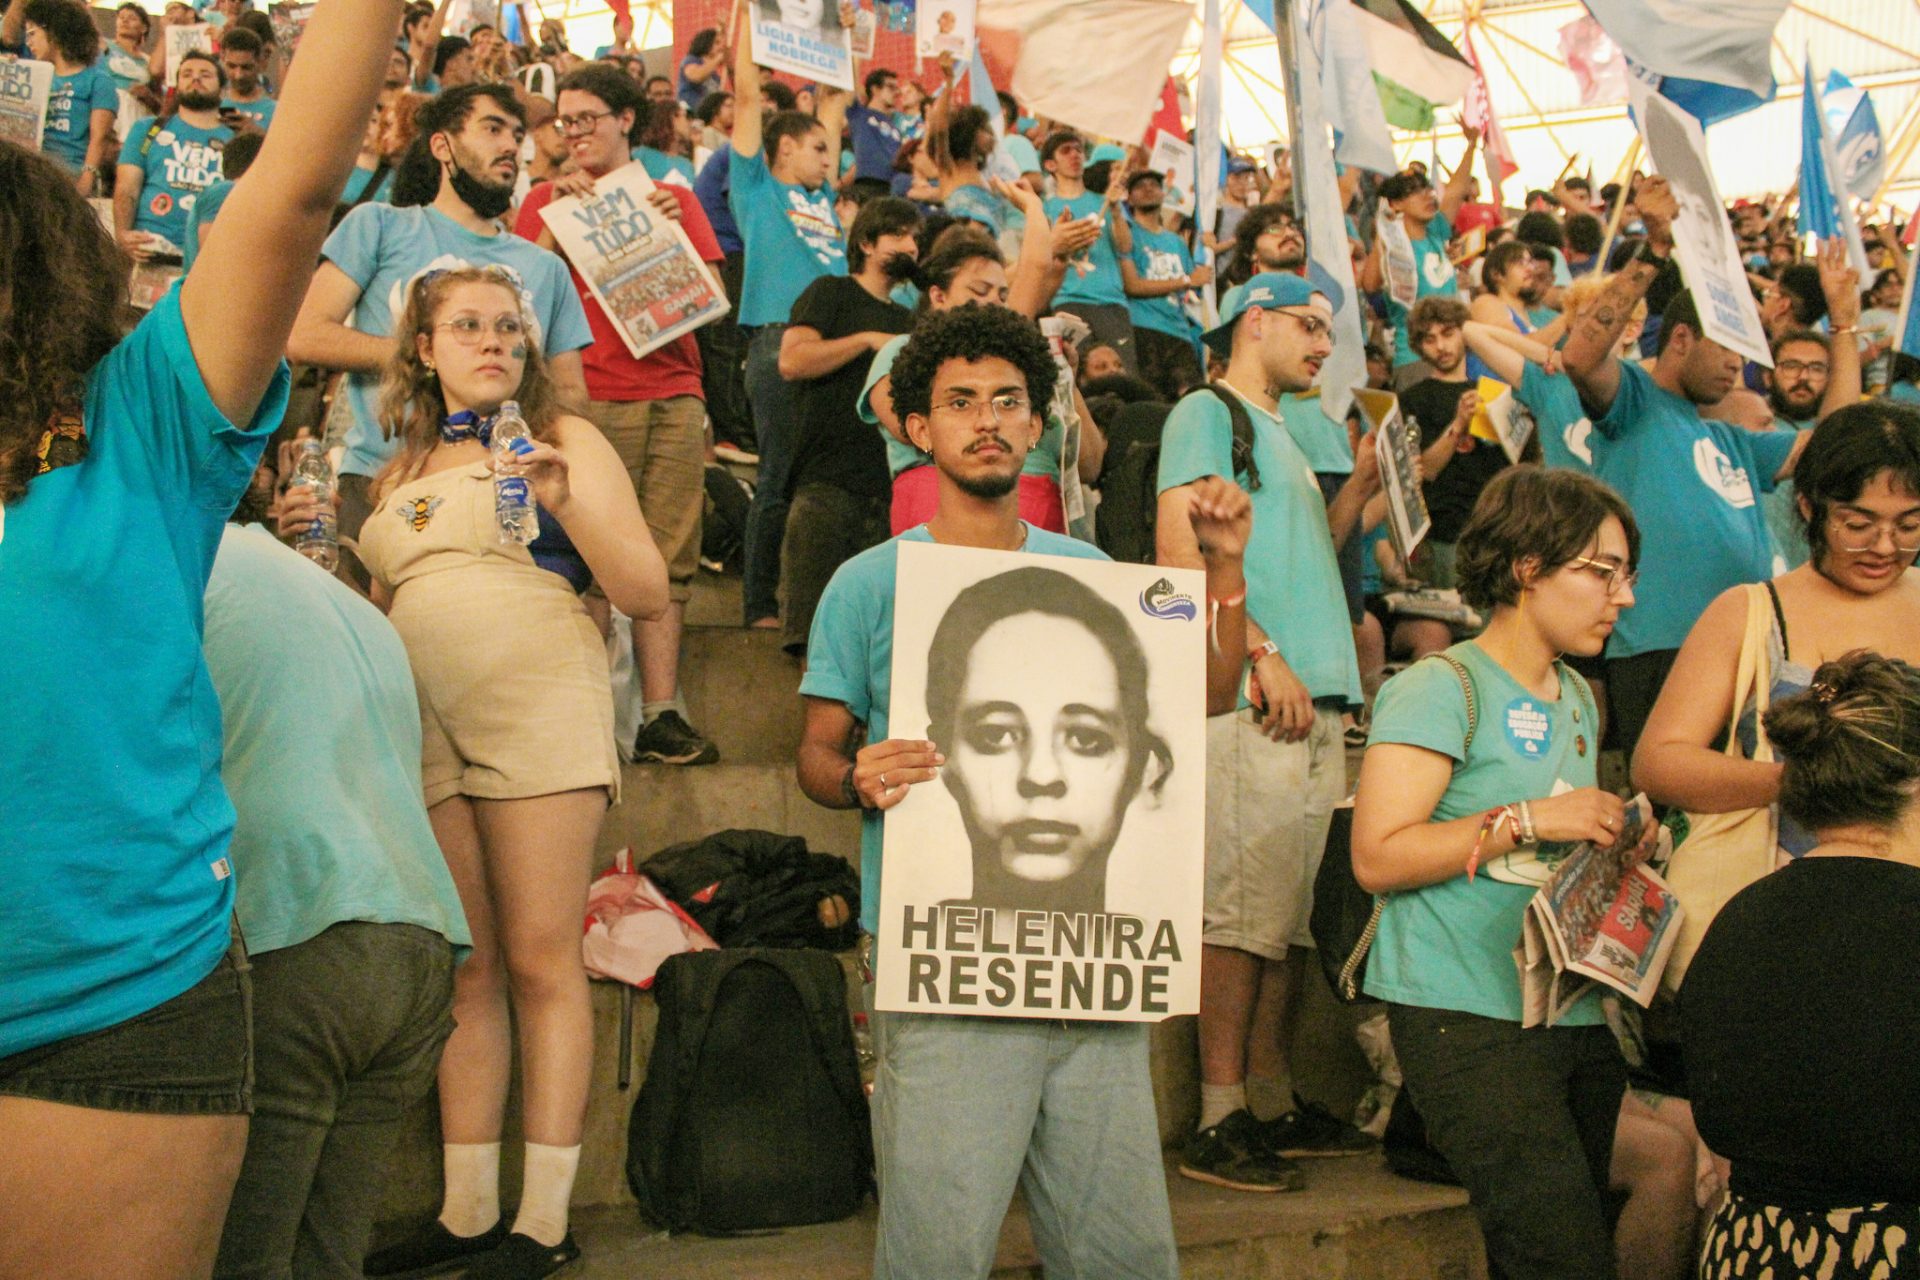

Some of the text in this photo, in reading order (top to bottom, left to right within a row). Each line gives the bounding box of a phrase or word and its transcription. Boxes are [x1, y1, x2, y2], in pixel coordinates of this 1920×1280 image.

[171, 140, 223, 172] VEM
[572, 187, 636, 228] VEM
[583, 211, 653, 256] TUDO
[902, 905, 1182, 962] HELENIRA
[908, 953, 1170, 1013] RESENDE
